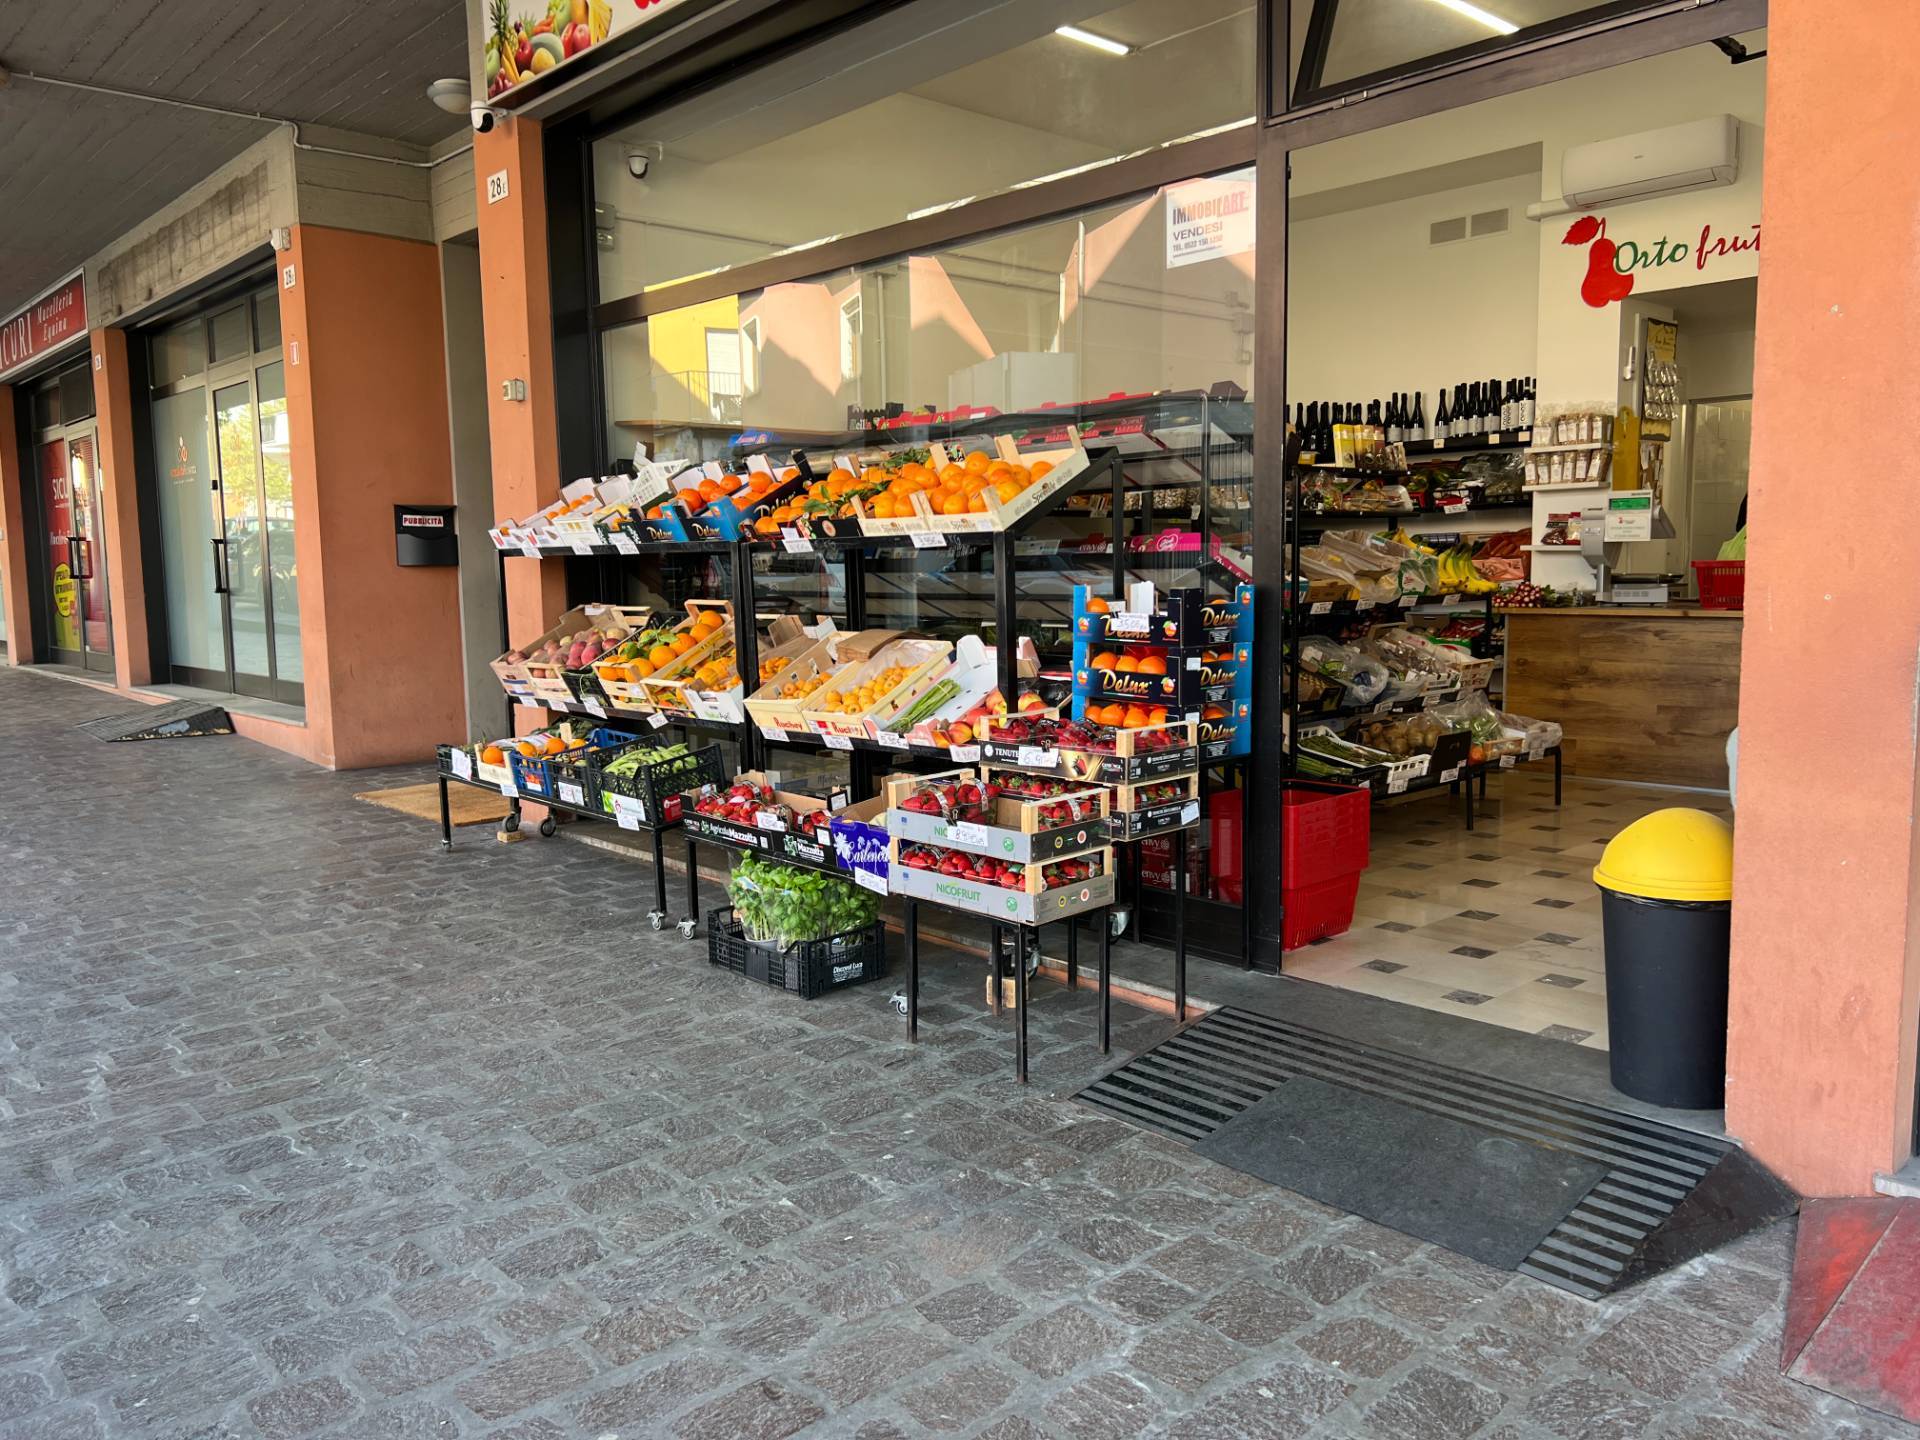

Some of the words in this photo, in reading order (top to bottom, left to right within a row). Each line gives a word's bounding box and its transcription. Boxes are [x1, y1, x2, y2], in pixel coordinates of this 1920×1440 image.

[1173, 221, 1223, 240] VENDESI
[1615, 235, 1689, 273] Orto
[1099, 669, 1151, 694] Delux
[936, 882, 981, 901] NICOFRUIT
